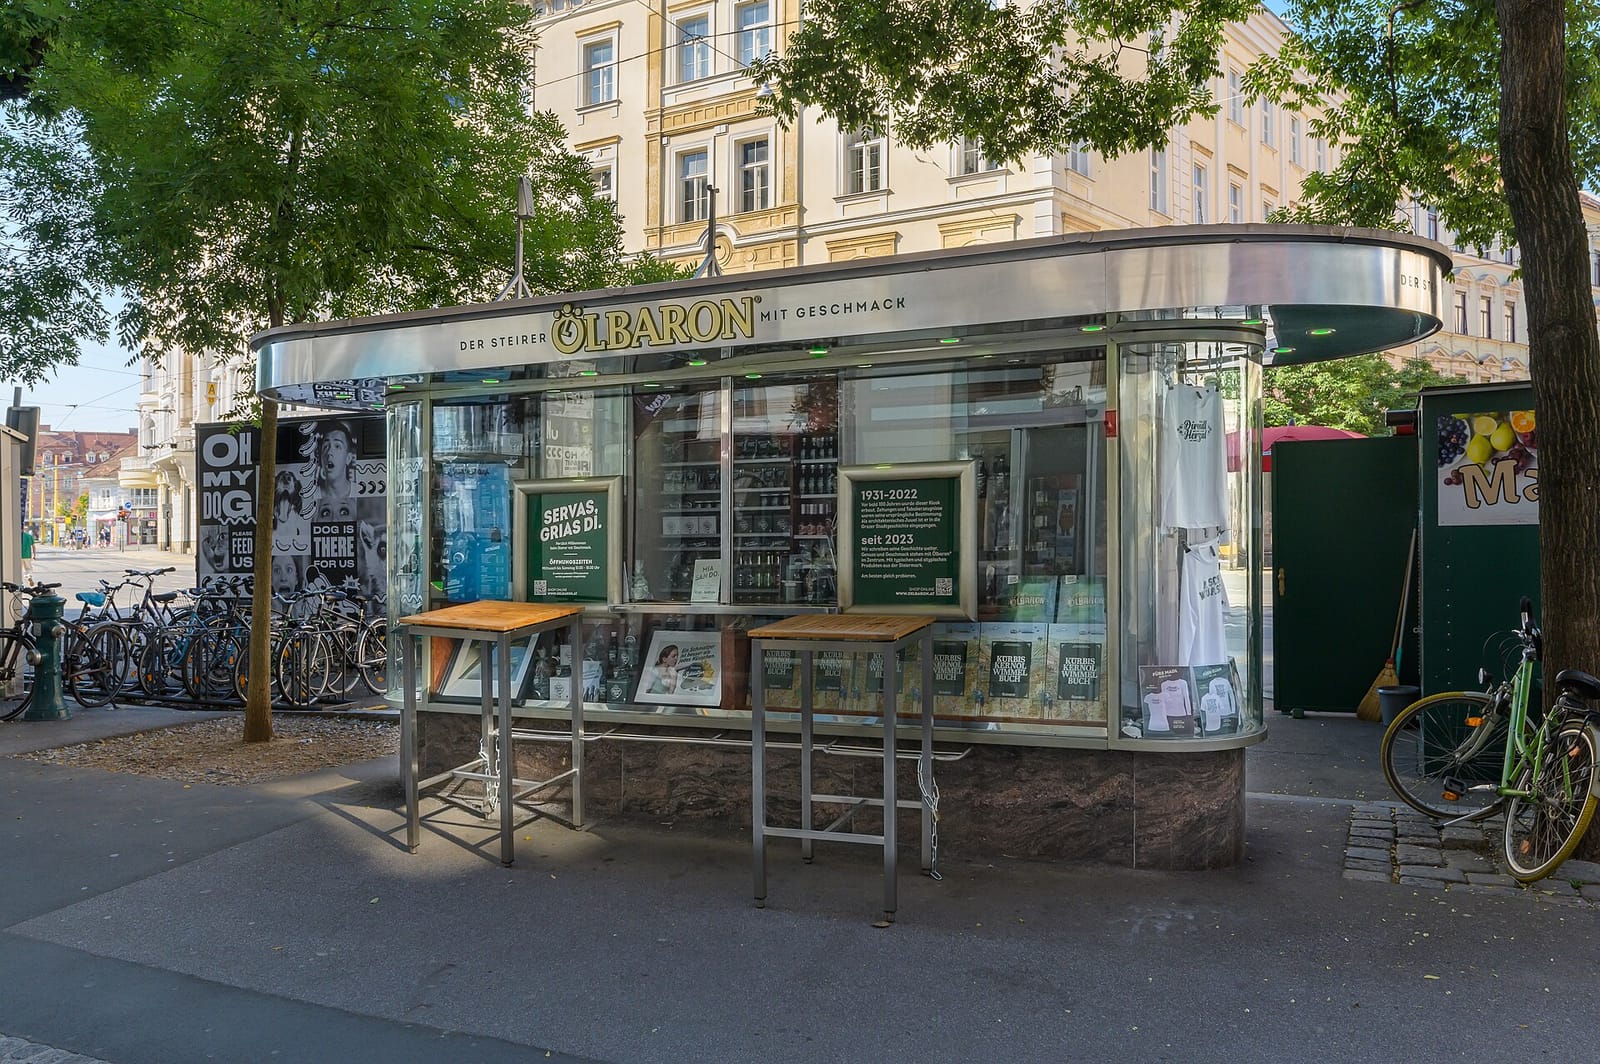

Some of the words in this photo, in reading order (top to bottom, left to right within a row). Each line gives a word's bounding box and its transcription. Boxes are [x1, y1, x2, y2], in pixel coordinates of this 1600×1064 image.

[1400, 274, 1419, 288] DER
[460, 340, 484, 351] DER
[491, 333, 548, 346] STEIRER
[760, 310, 787, 322] MIT
[796, 297, 906, 319] GESCHMACK
[202, 432, 252, 468] OH
[202, 470, 254, 488] MY
[1459, 459, 1540, 510] Ma
[861, 488, 918, 500] 1931-2022
[202, 490, 252, 520] DOG
[544, 500, 598, 524] SERVAS,
[313, 526, 339, 534] DOG
[342, 525, 354, 534] IS
[540, 520, 580, 542] GRIAS
[232, 538, 252, 554] FEED
[861, 534, 882, 545] seit
[885, 534, 914, 545] 2023
[314, 536, 354, 558] THERE
[232, 557, 254, 568] US
[314, 560, 336, 569] FOR
[338, 560, 354, 568] US
[993, 668, 1028, 676] WIMMEL
[999, 675, 1021, 683] BUCH
[1061, 670, 1098, 678] WIMMEL
[1068, 676, 1090, 685] BUCH
